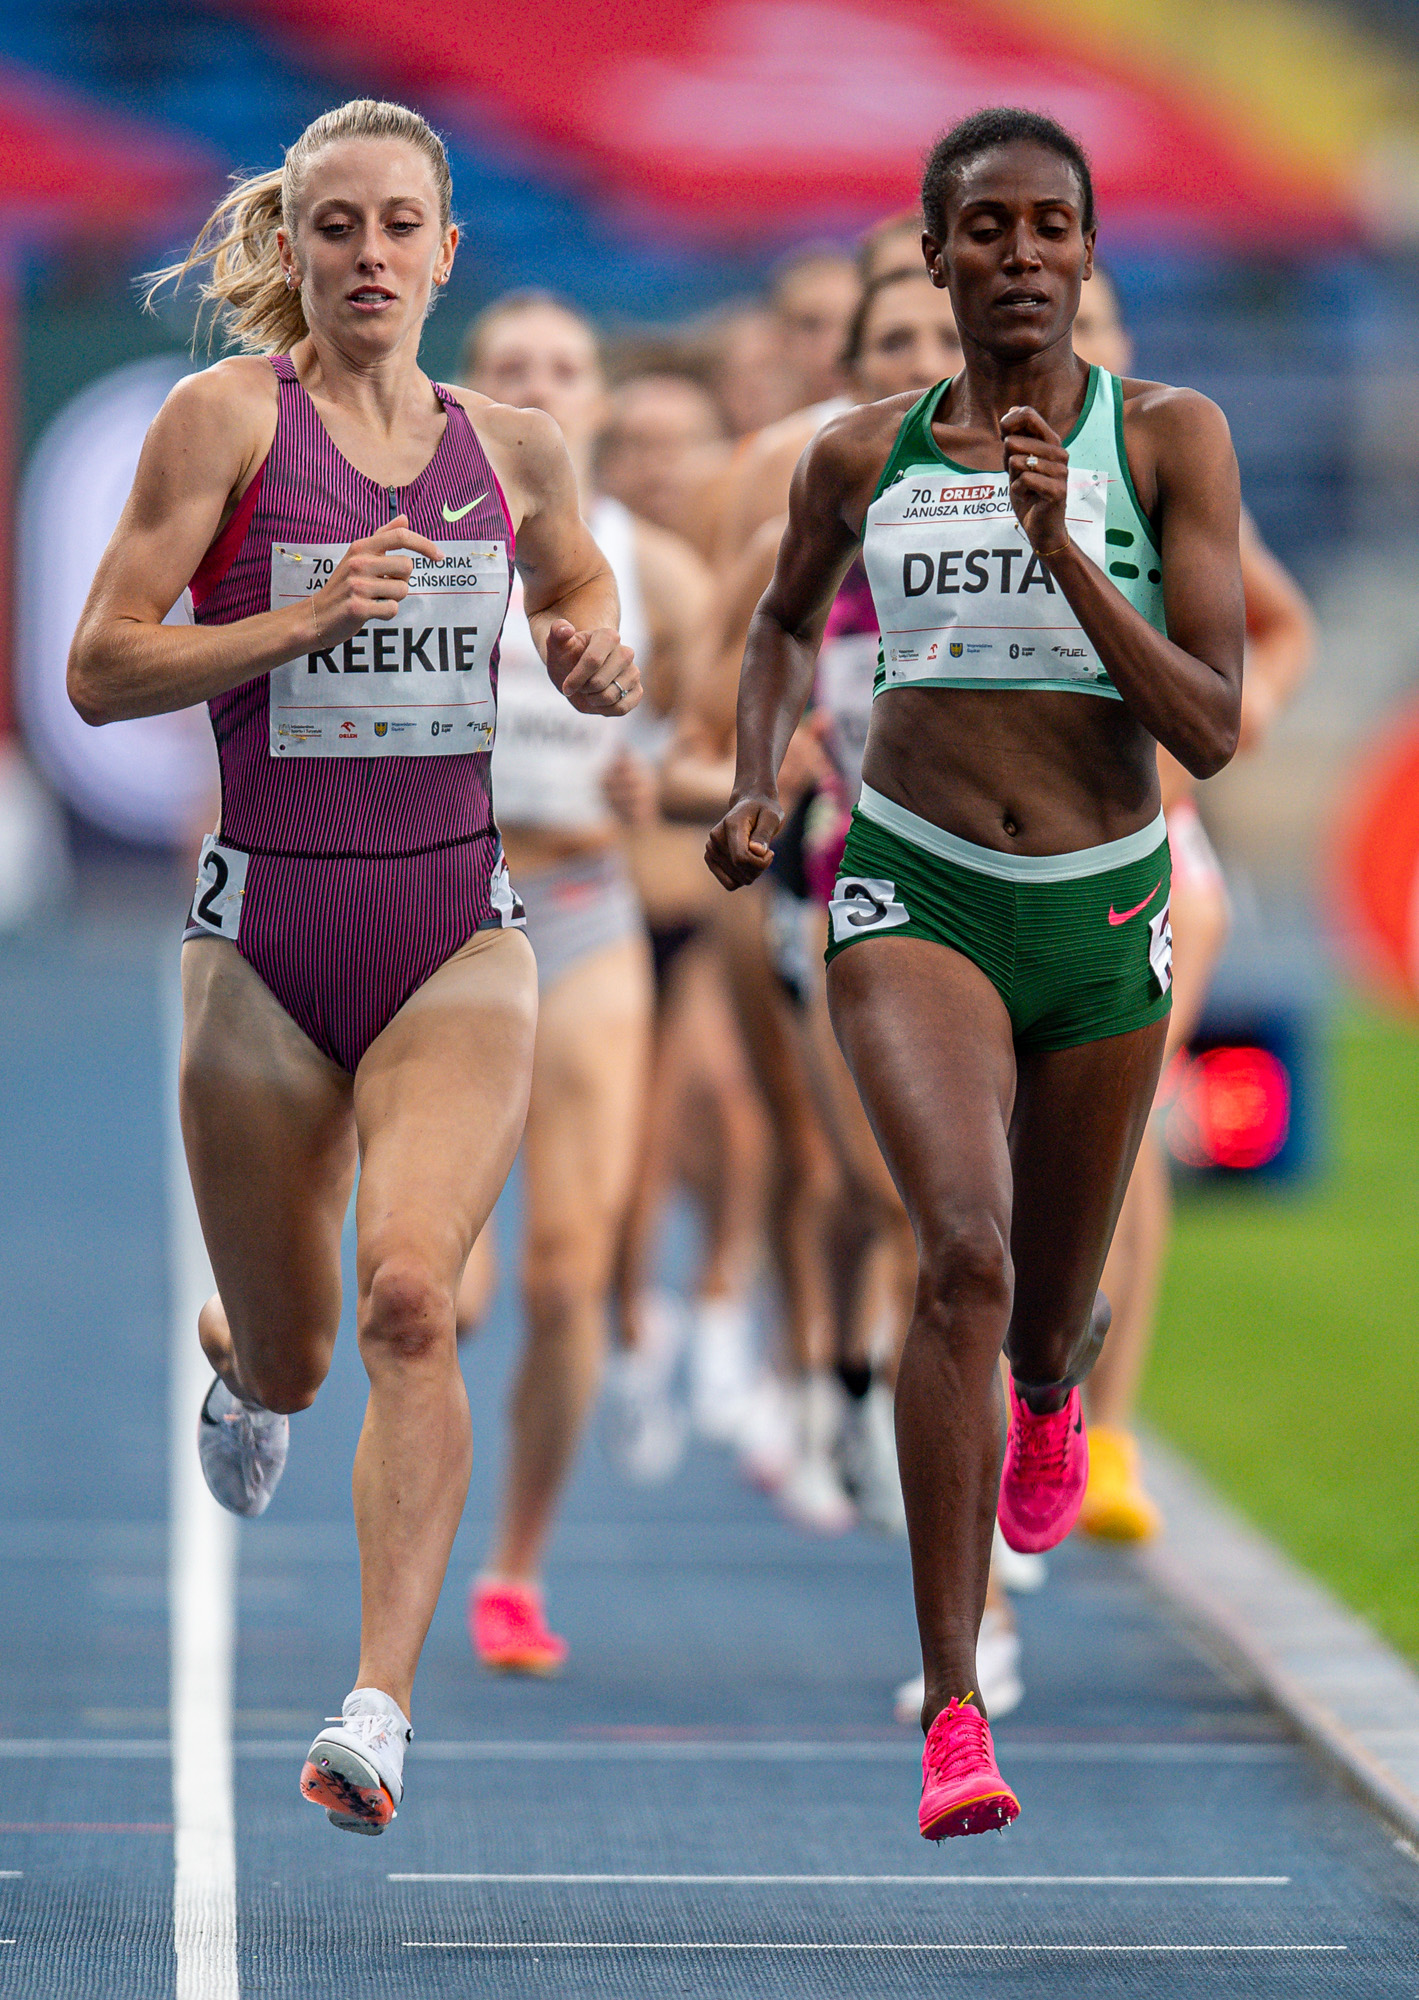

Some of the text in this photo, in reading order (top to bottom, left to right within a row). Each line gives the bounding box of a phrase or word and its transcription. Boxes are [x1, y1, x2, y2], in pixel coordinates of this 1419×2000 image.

[902, 504, 959, 519] JANUSZA
[911, 489, 935, 504] 70.
[942, 486, 993, 501] ORLEN
[312, 558, 334, 574] 70
[902, 548, 1057, 598] DESTA
[307, 626, 479, 675] REEKIE
[196, 849, 229, 929] 2
